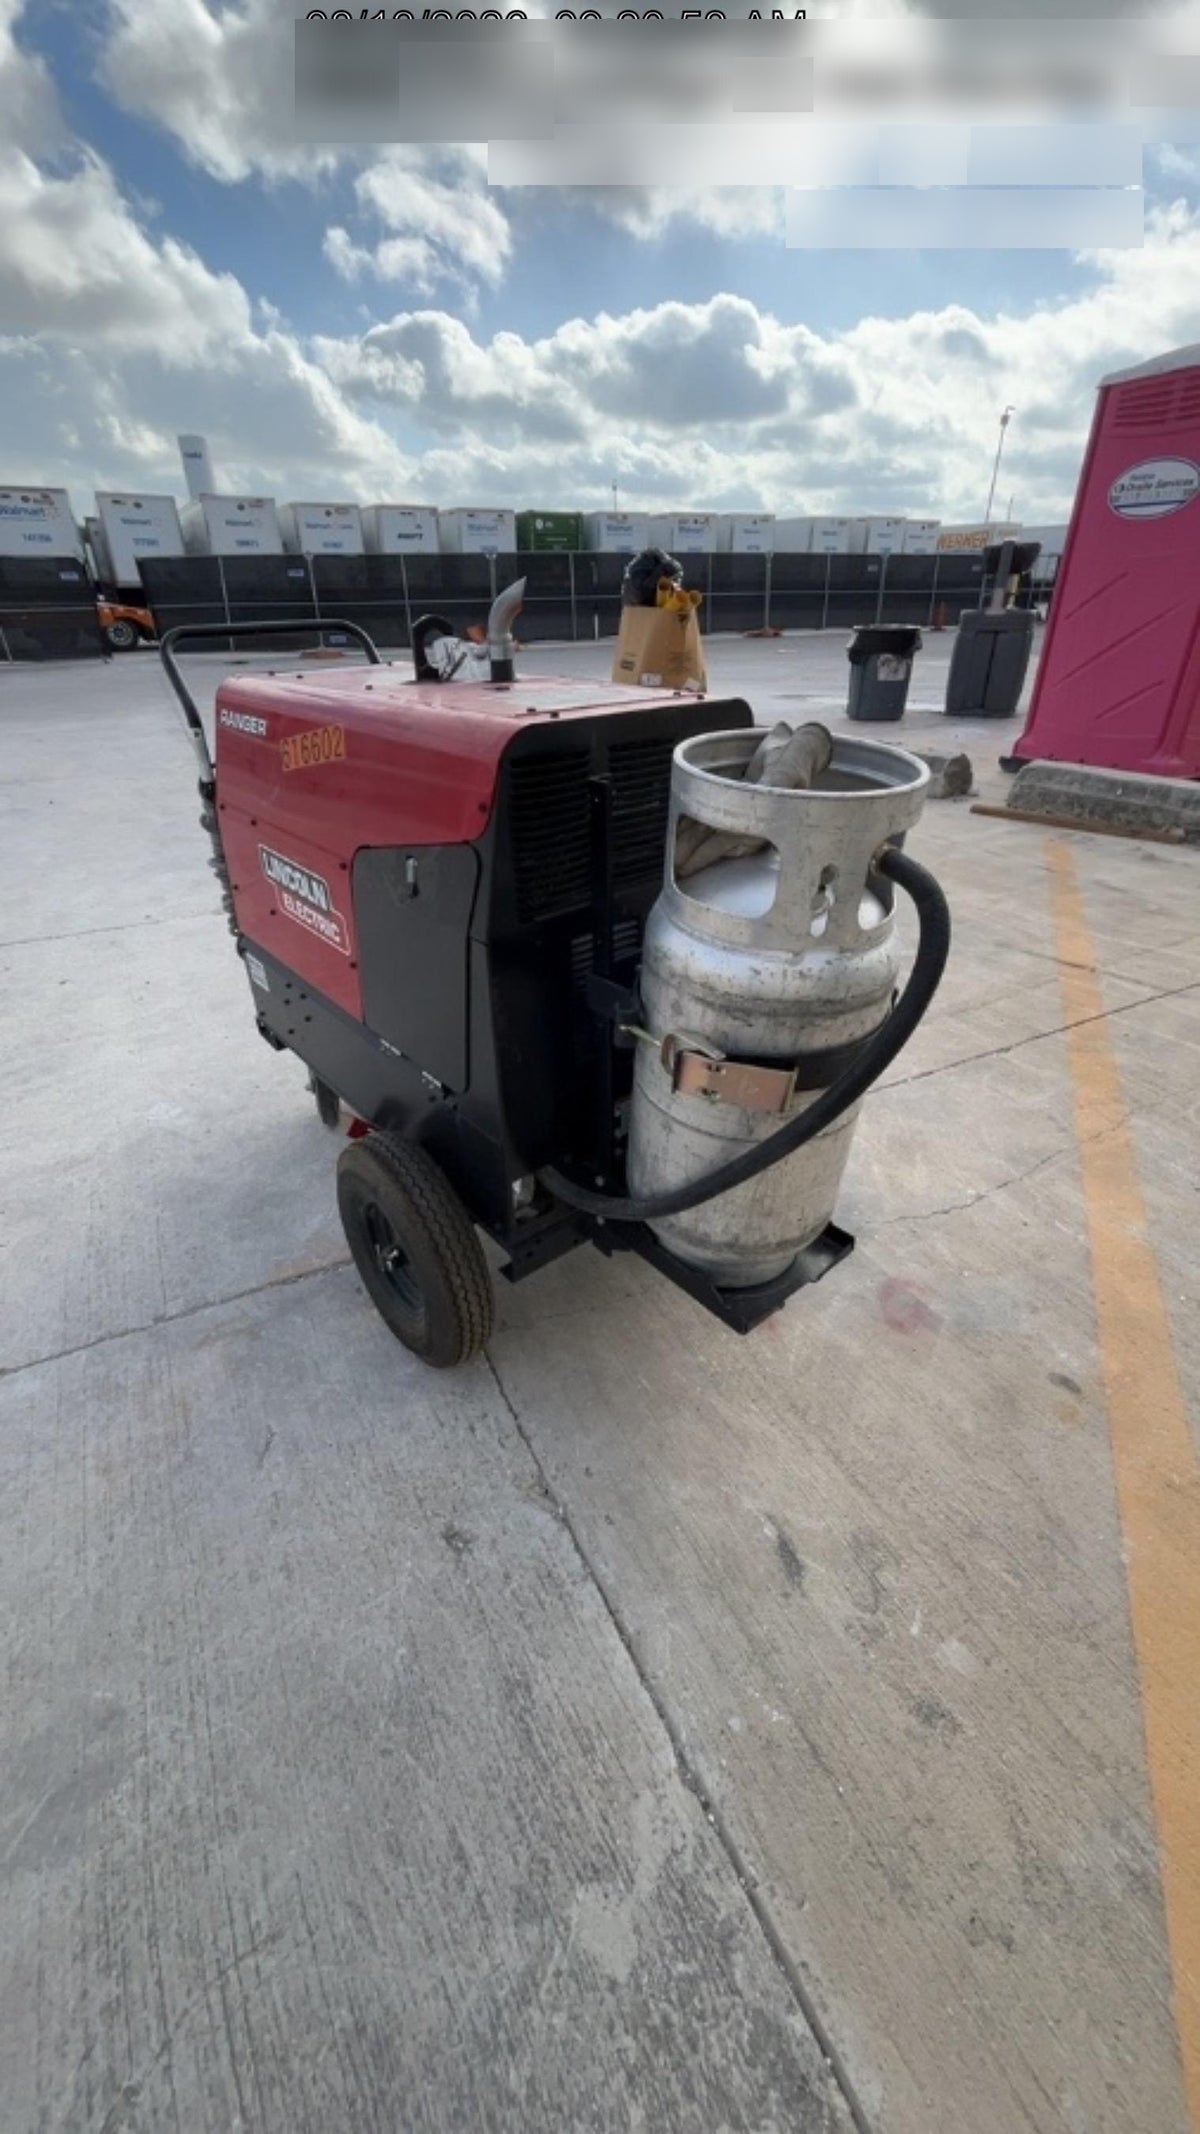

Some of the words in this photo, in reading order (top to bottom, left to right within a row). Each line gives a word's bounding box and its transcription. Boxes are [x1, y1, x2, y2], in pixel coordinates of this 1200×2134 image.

[220, 709, 267, 737] RANGER
[281, 724, 343, 769] 616602
[262, 851, 329, 911] LINCOLN
[282, 893, 341, 943] ELECTRIC
